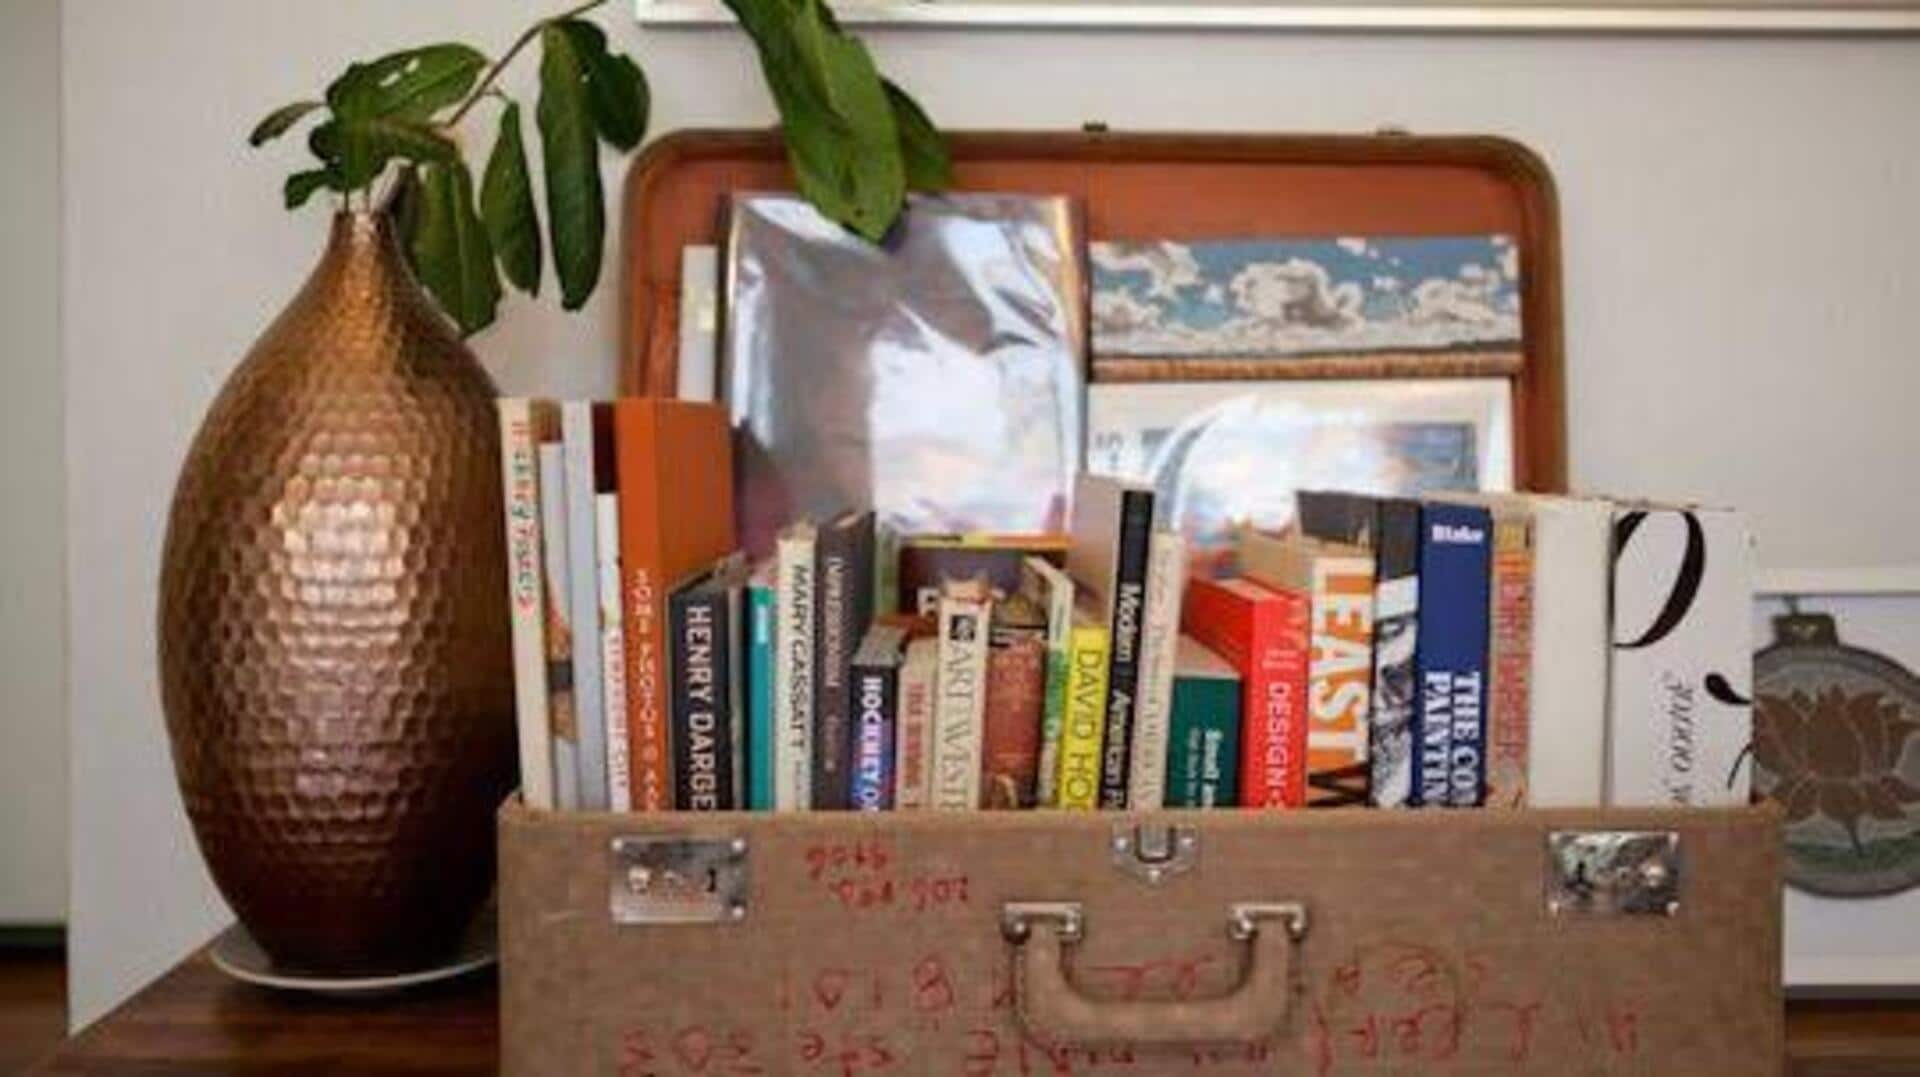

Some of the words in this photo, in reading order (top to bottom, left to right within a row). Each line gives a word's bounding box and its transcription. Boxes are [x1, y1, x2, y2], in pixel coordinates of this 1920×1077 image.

[1431, 524, 1484, 545] Blake
[791, 564, 810, 632] MARY
[1116, 583, 1141, 662] Modern
[687, 605, 713, 703] HENRY
[790, 639, 809, 750] CASSATT
[948, 642, 977, 701] ART
[1069, 649, 1102, 740] DAVID
[1307, 556, 1375, 761] LEAST
[862, 676, 883, 781] HOCKNEY
[1105, 688, 1132, 786] American
[1422, 671, 1452, 801] PAINTIN
[1452, 671, 1481, 741] THE
